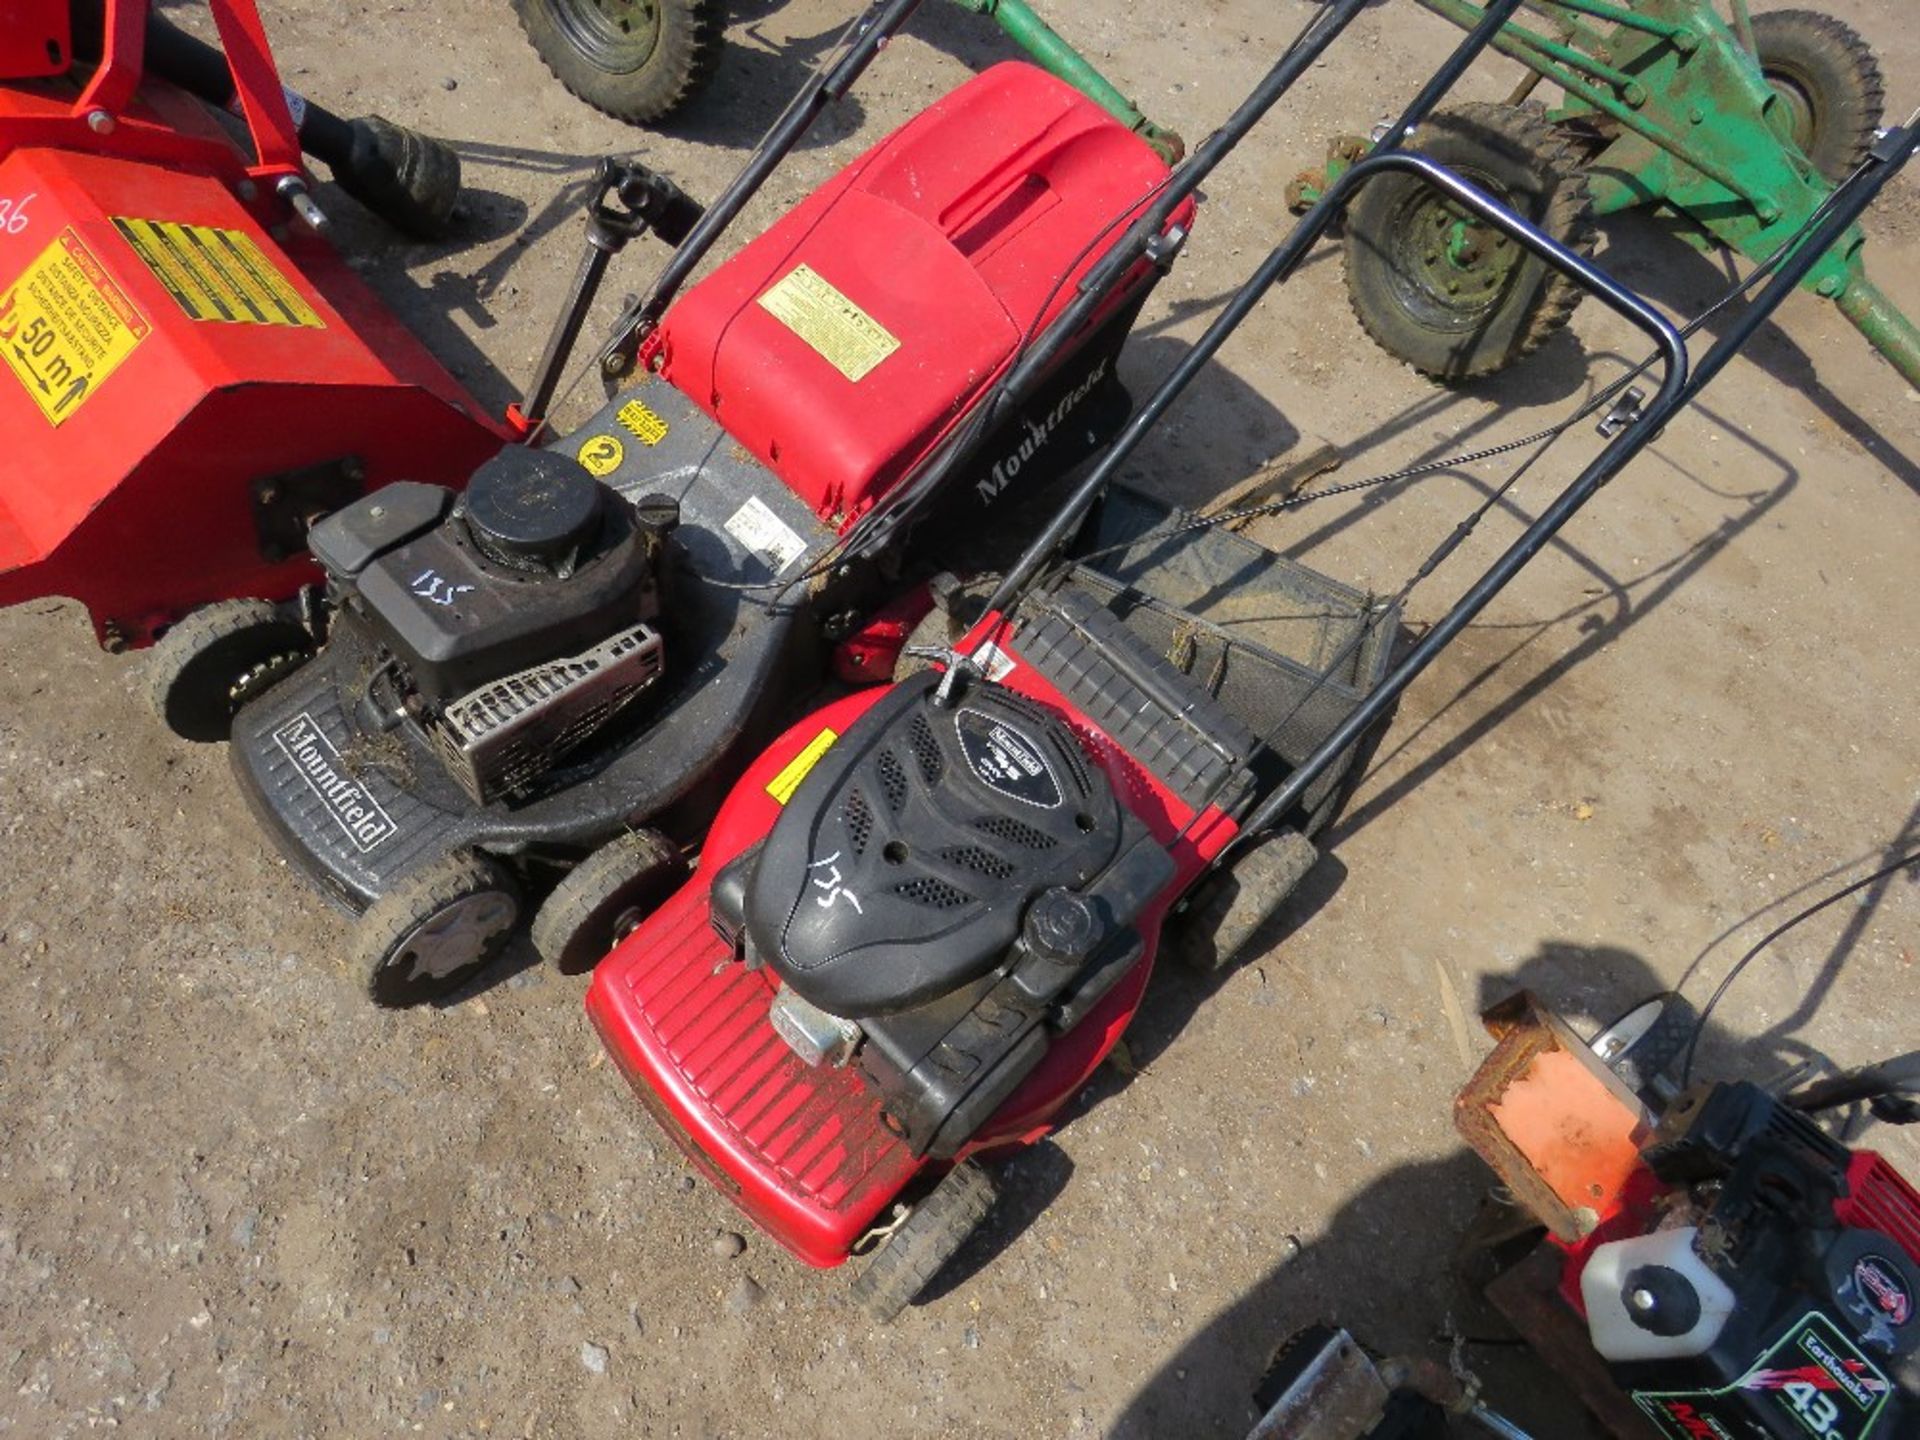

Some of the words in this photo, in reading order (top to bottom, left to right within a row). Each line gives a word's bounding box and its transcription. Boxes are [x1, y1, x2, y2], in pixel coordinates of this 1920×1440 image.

[36, 270, 69, 310] DISTANCE
[64, 306, 77, 321] DE
[49, 262, 80, 301] DISTANZA
[62, 256, 90, 287] SAFETY
[87, 289, 121, 331] DISTANCE
[21, 316, 56, 358] 50
[44, 354, 72, 388] m
[281, 720, 387, 844] Mountfield
